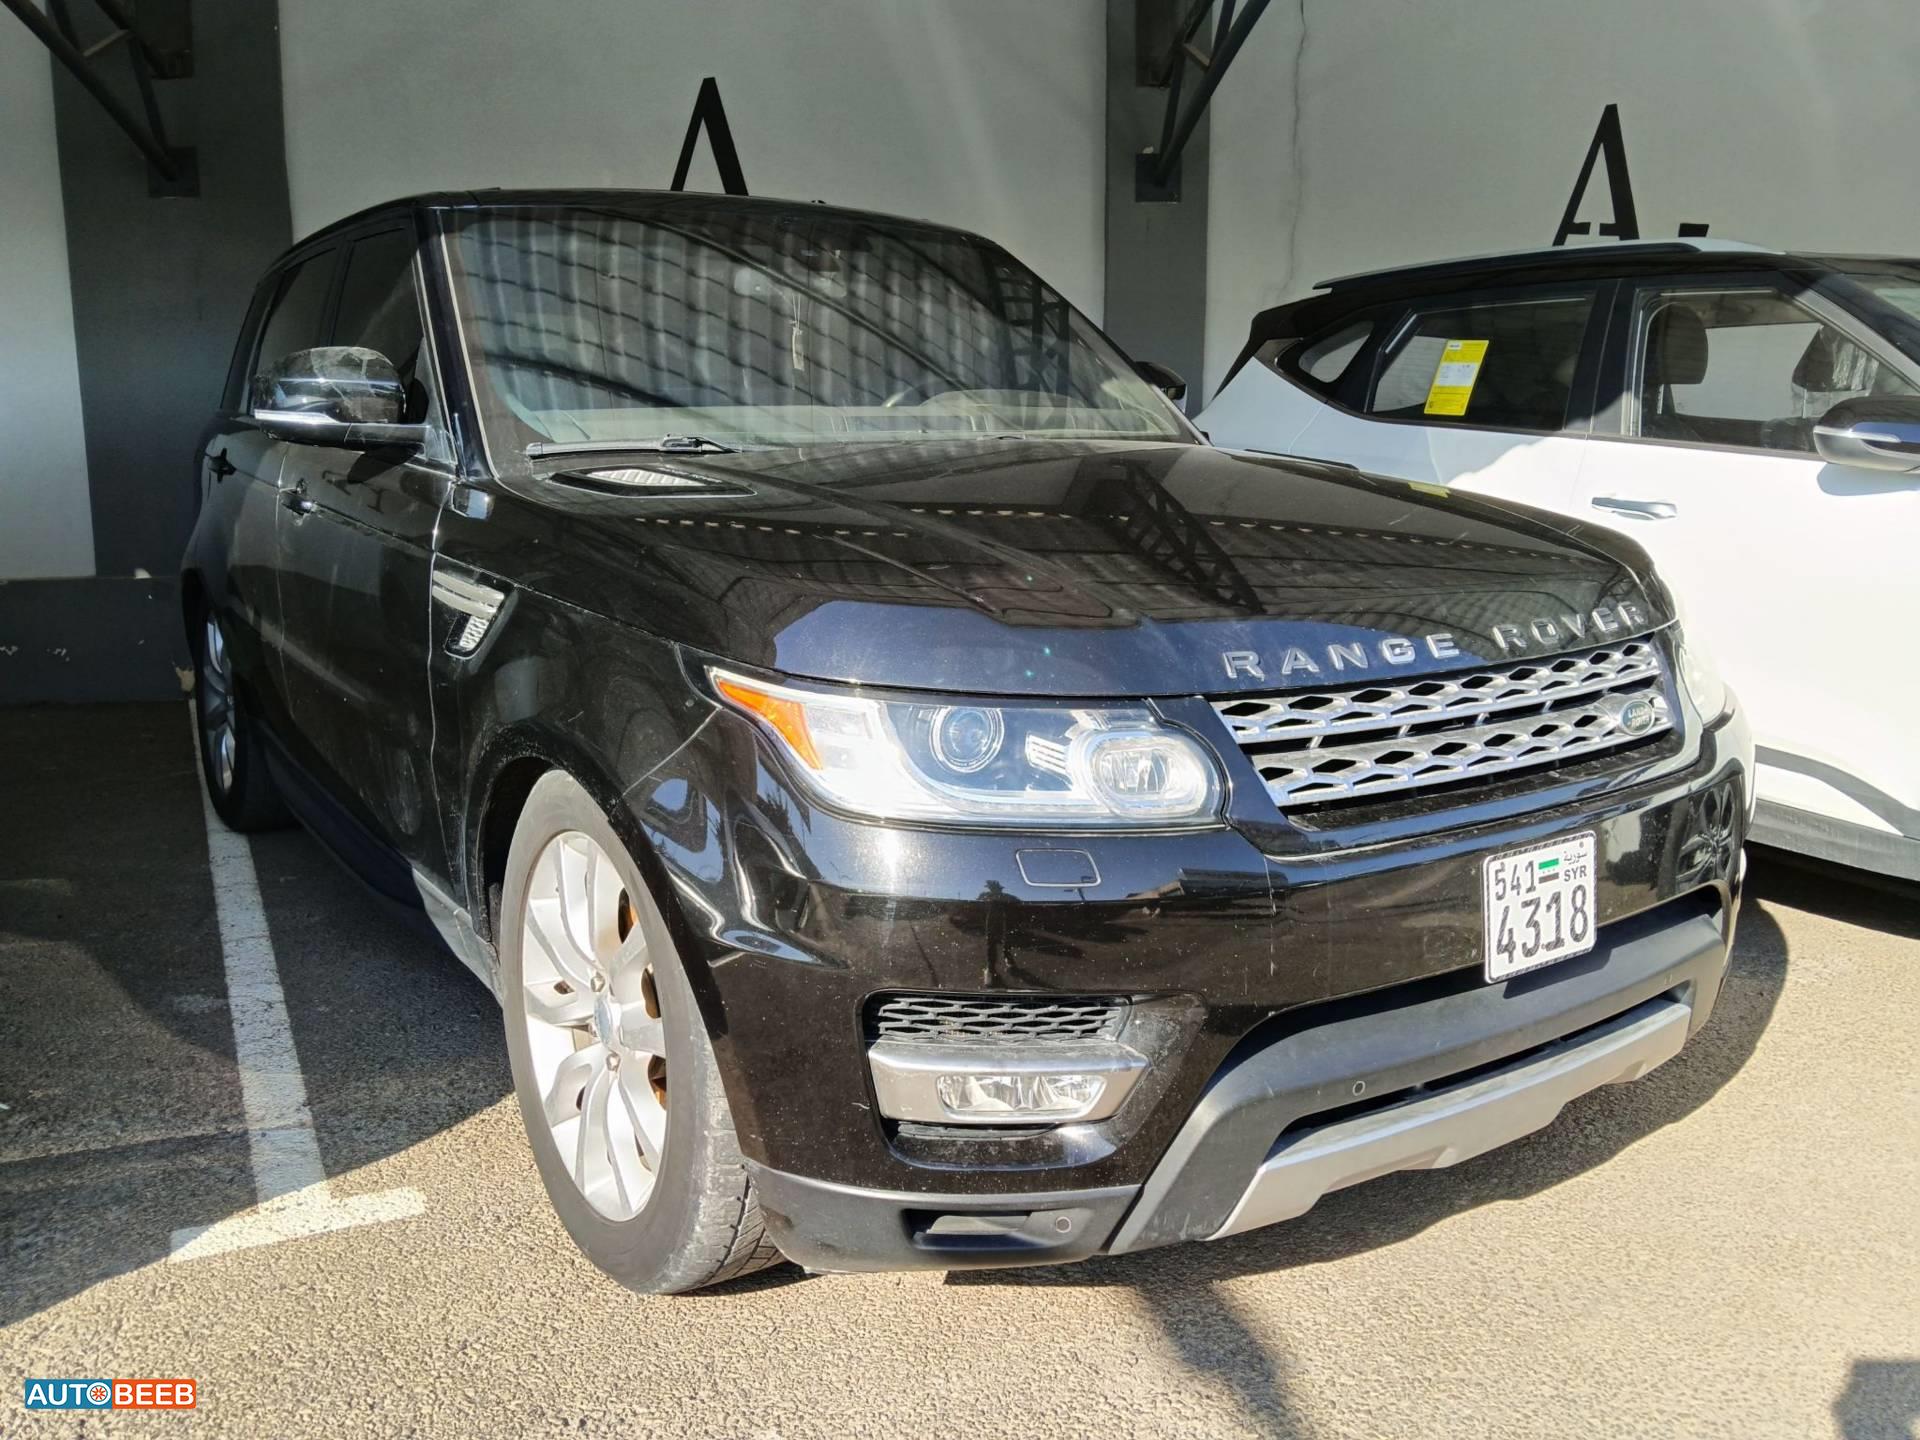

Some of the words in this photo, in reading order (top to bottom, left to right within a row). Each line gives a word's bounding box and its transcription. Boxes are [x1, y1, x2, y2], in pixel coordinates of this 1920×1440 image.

[1223, 633, 1460, 681] RANGE
[1493, 601, 1645, 649] ROVER
[1495, 860, 1537, 901] 541
[1564, 865, 1588, 882] SYR
[1496, 884, 1589, 964] 4318
